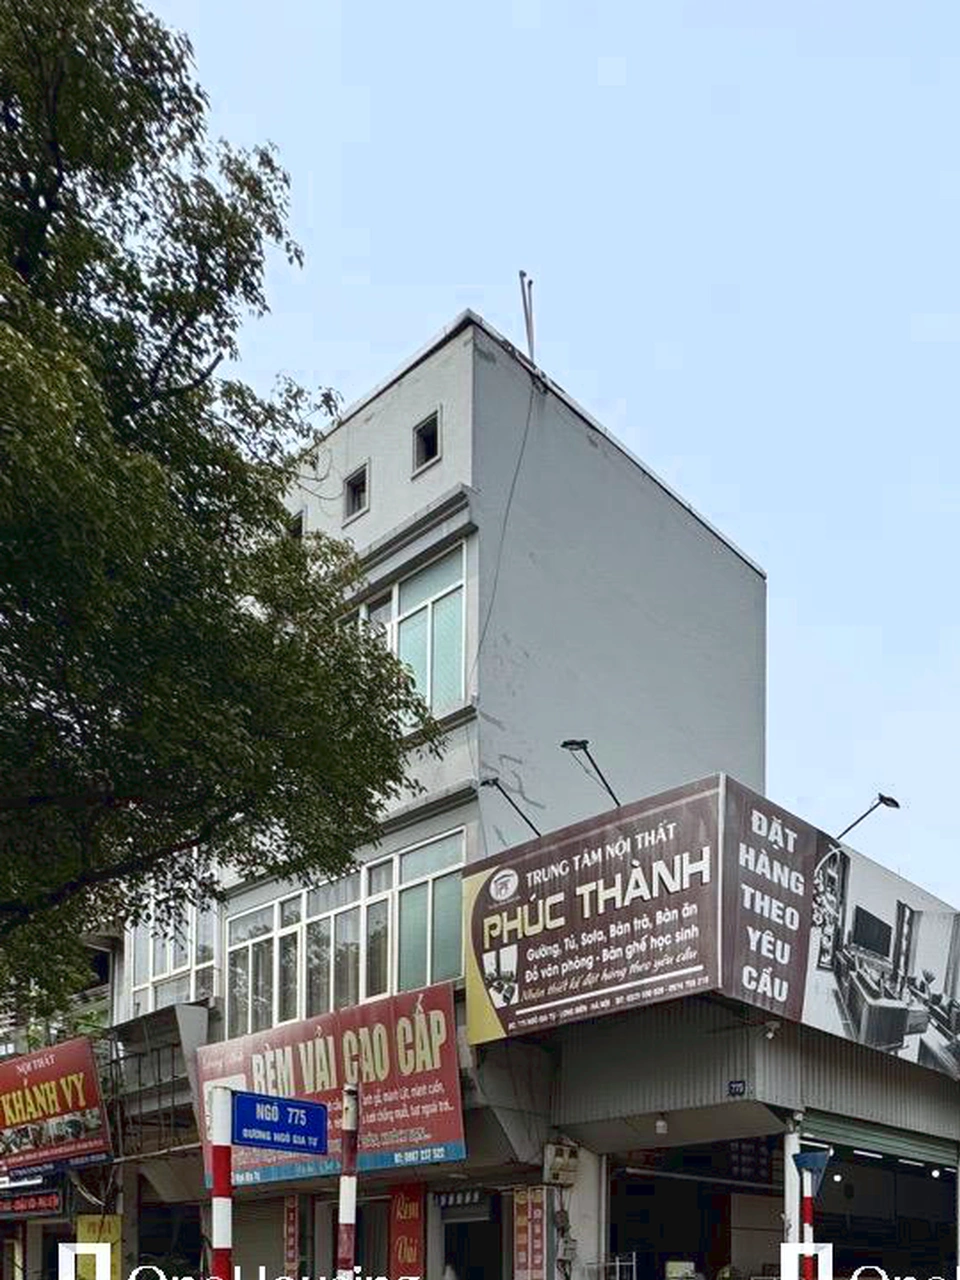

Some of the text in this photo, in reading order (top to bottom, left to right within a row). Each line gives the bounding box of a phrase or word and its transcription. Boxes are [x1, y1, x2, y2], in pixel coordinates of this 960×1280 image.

[526, 820, 676, 888] TRUNG TÂM NỘI THẤT
[750, 808, 797, 852] ĐẶT
[739, 842, 804, 896] HÀNG
[483, 846, 711, 949] PHÚC THÀNH
[740, 884, 799, 930] THEO
[581, 928, 607, 946] Sofa,
[609, 921, 631, 938] Bàn
[656, 907, 679, 926] Bàn
[681, 902, 698, 919] ăn
[746, 926, 790, 965] YÊU
[540, 963, 559, 979] văn
[602, 945, 623, 963] Bàn
[625, 934, 648, 960] ghế
[650, 934, 672, 952] học
[674, 923, 700, 944] sinh
[742, 963, 789, 1002] CẦU
[252, 992, 447, 1098] RÈM VẢI CAO CẤP
[1, 1071, 87, 1127] KHÁNH VY
[286, 1107, 307, 1127] 775
